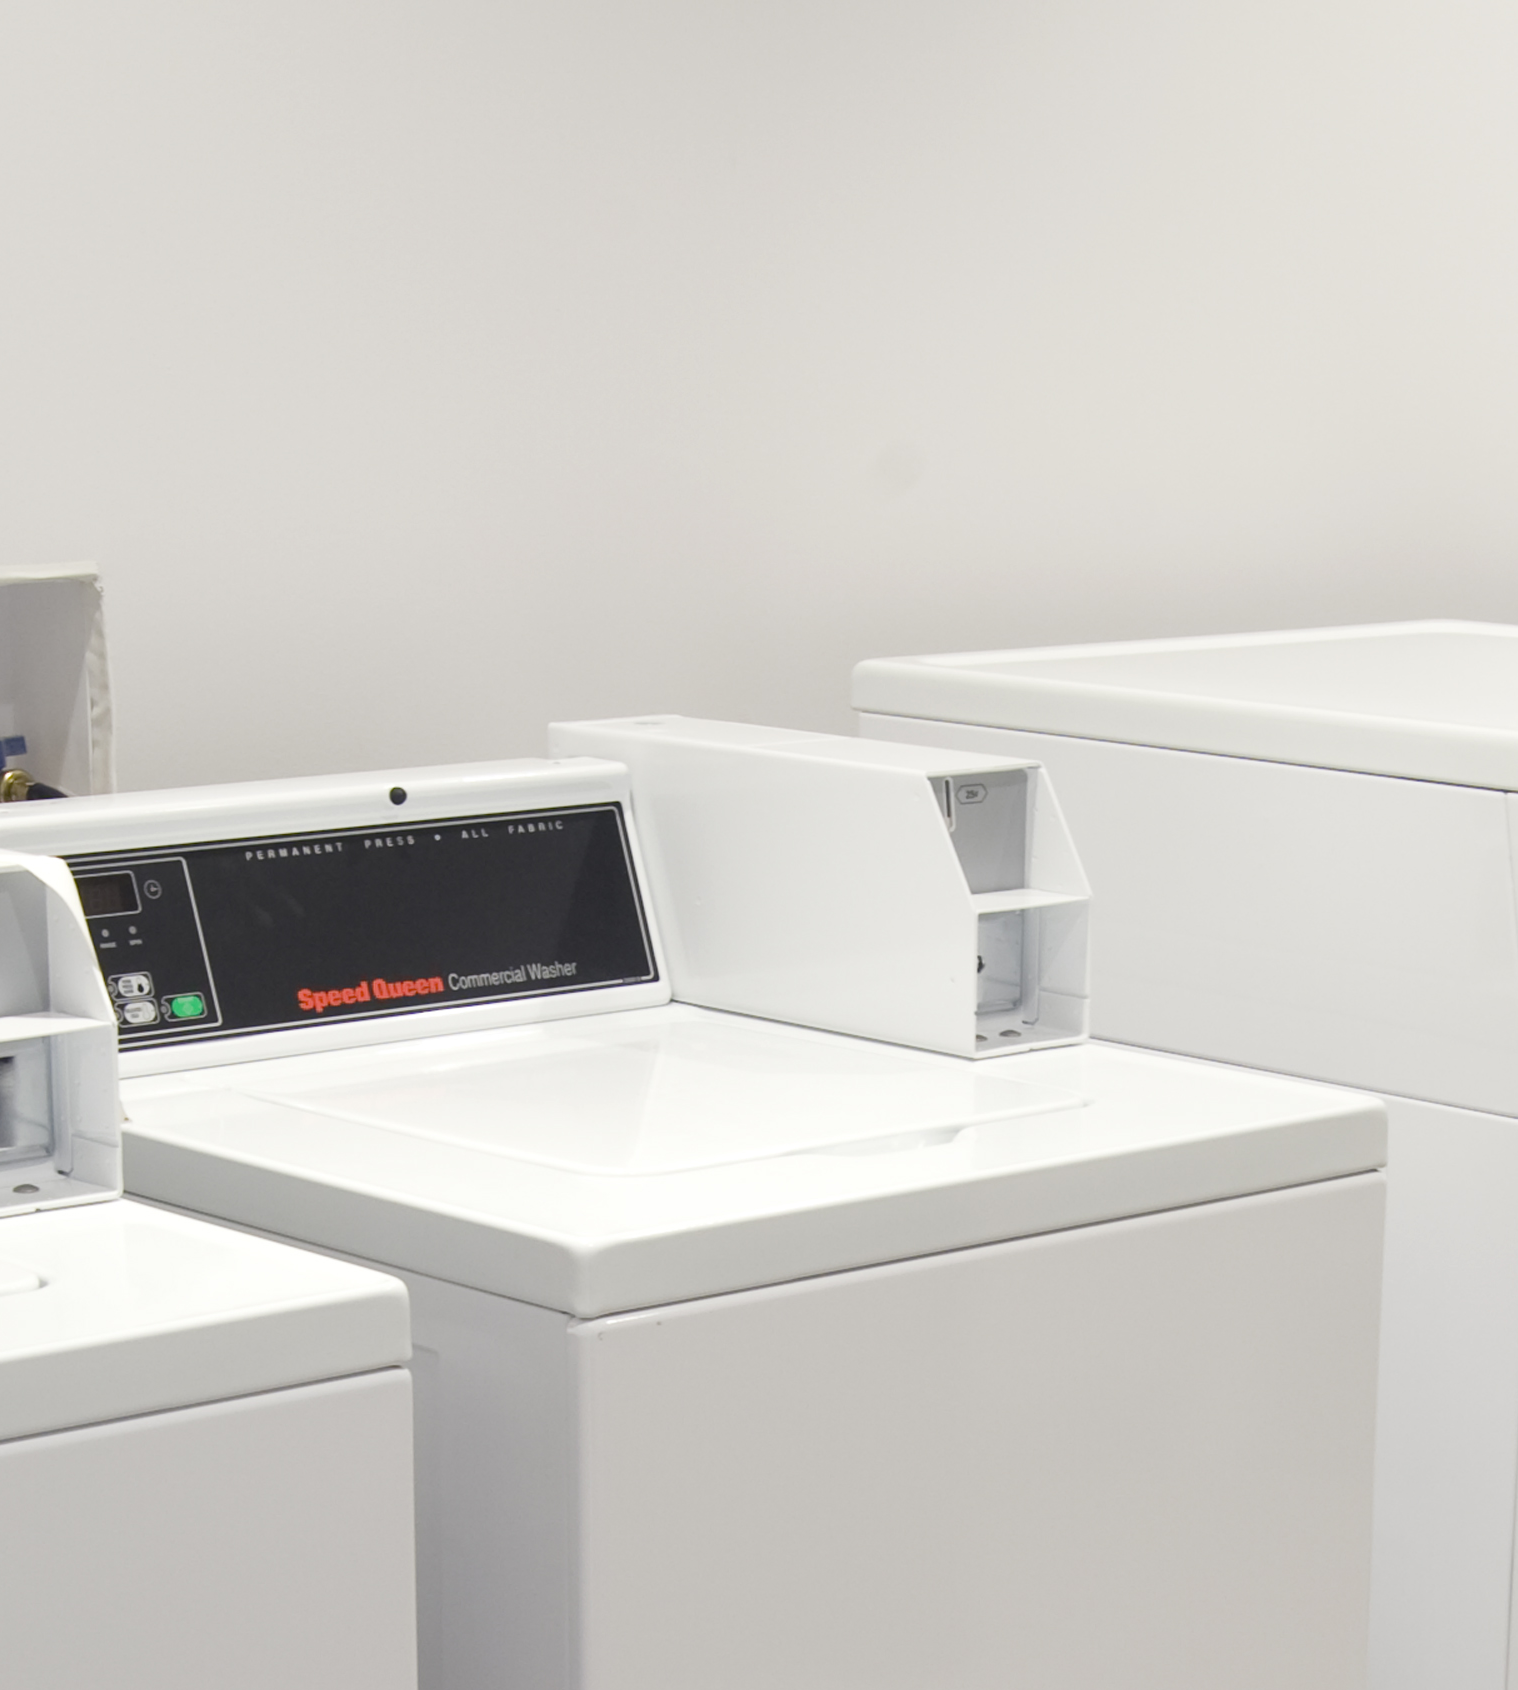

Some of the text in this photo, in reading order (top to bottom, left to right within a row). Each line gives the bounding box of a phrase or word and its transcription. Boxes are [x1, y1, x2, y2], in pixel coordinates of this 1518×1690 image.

[245, 820, 564, 861] PERMANENT PRESS ALL FABRIC
[297, 961, 577, 1013] Speed Queen Commercial Washer
